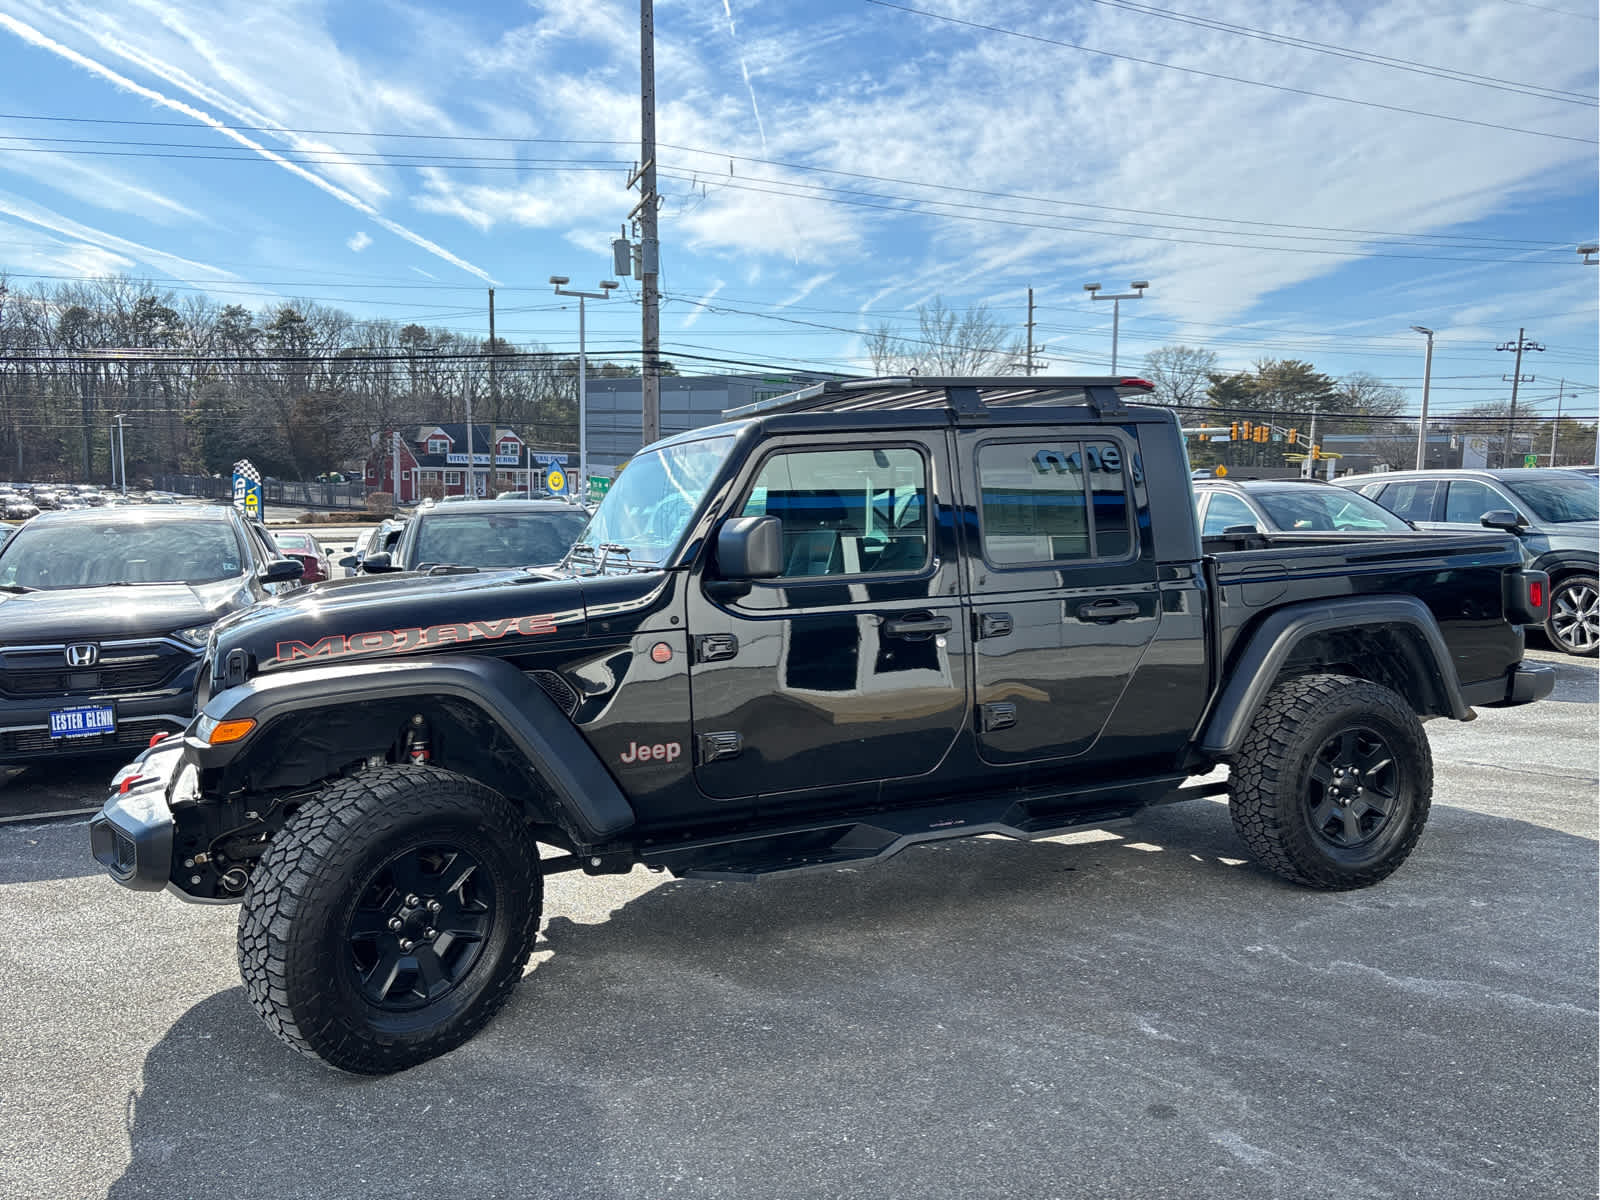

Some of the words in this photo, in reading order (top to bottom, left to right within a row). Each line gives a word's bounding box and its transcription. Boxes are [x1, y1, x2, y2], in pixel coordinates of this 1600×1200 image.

[276, 614, 557, 662] MOJAVE
[51, 713, 83, 731] LESTER
[86, 710, 113, 728] GLENN
[620, 742, 681, 763] Jeep
